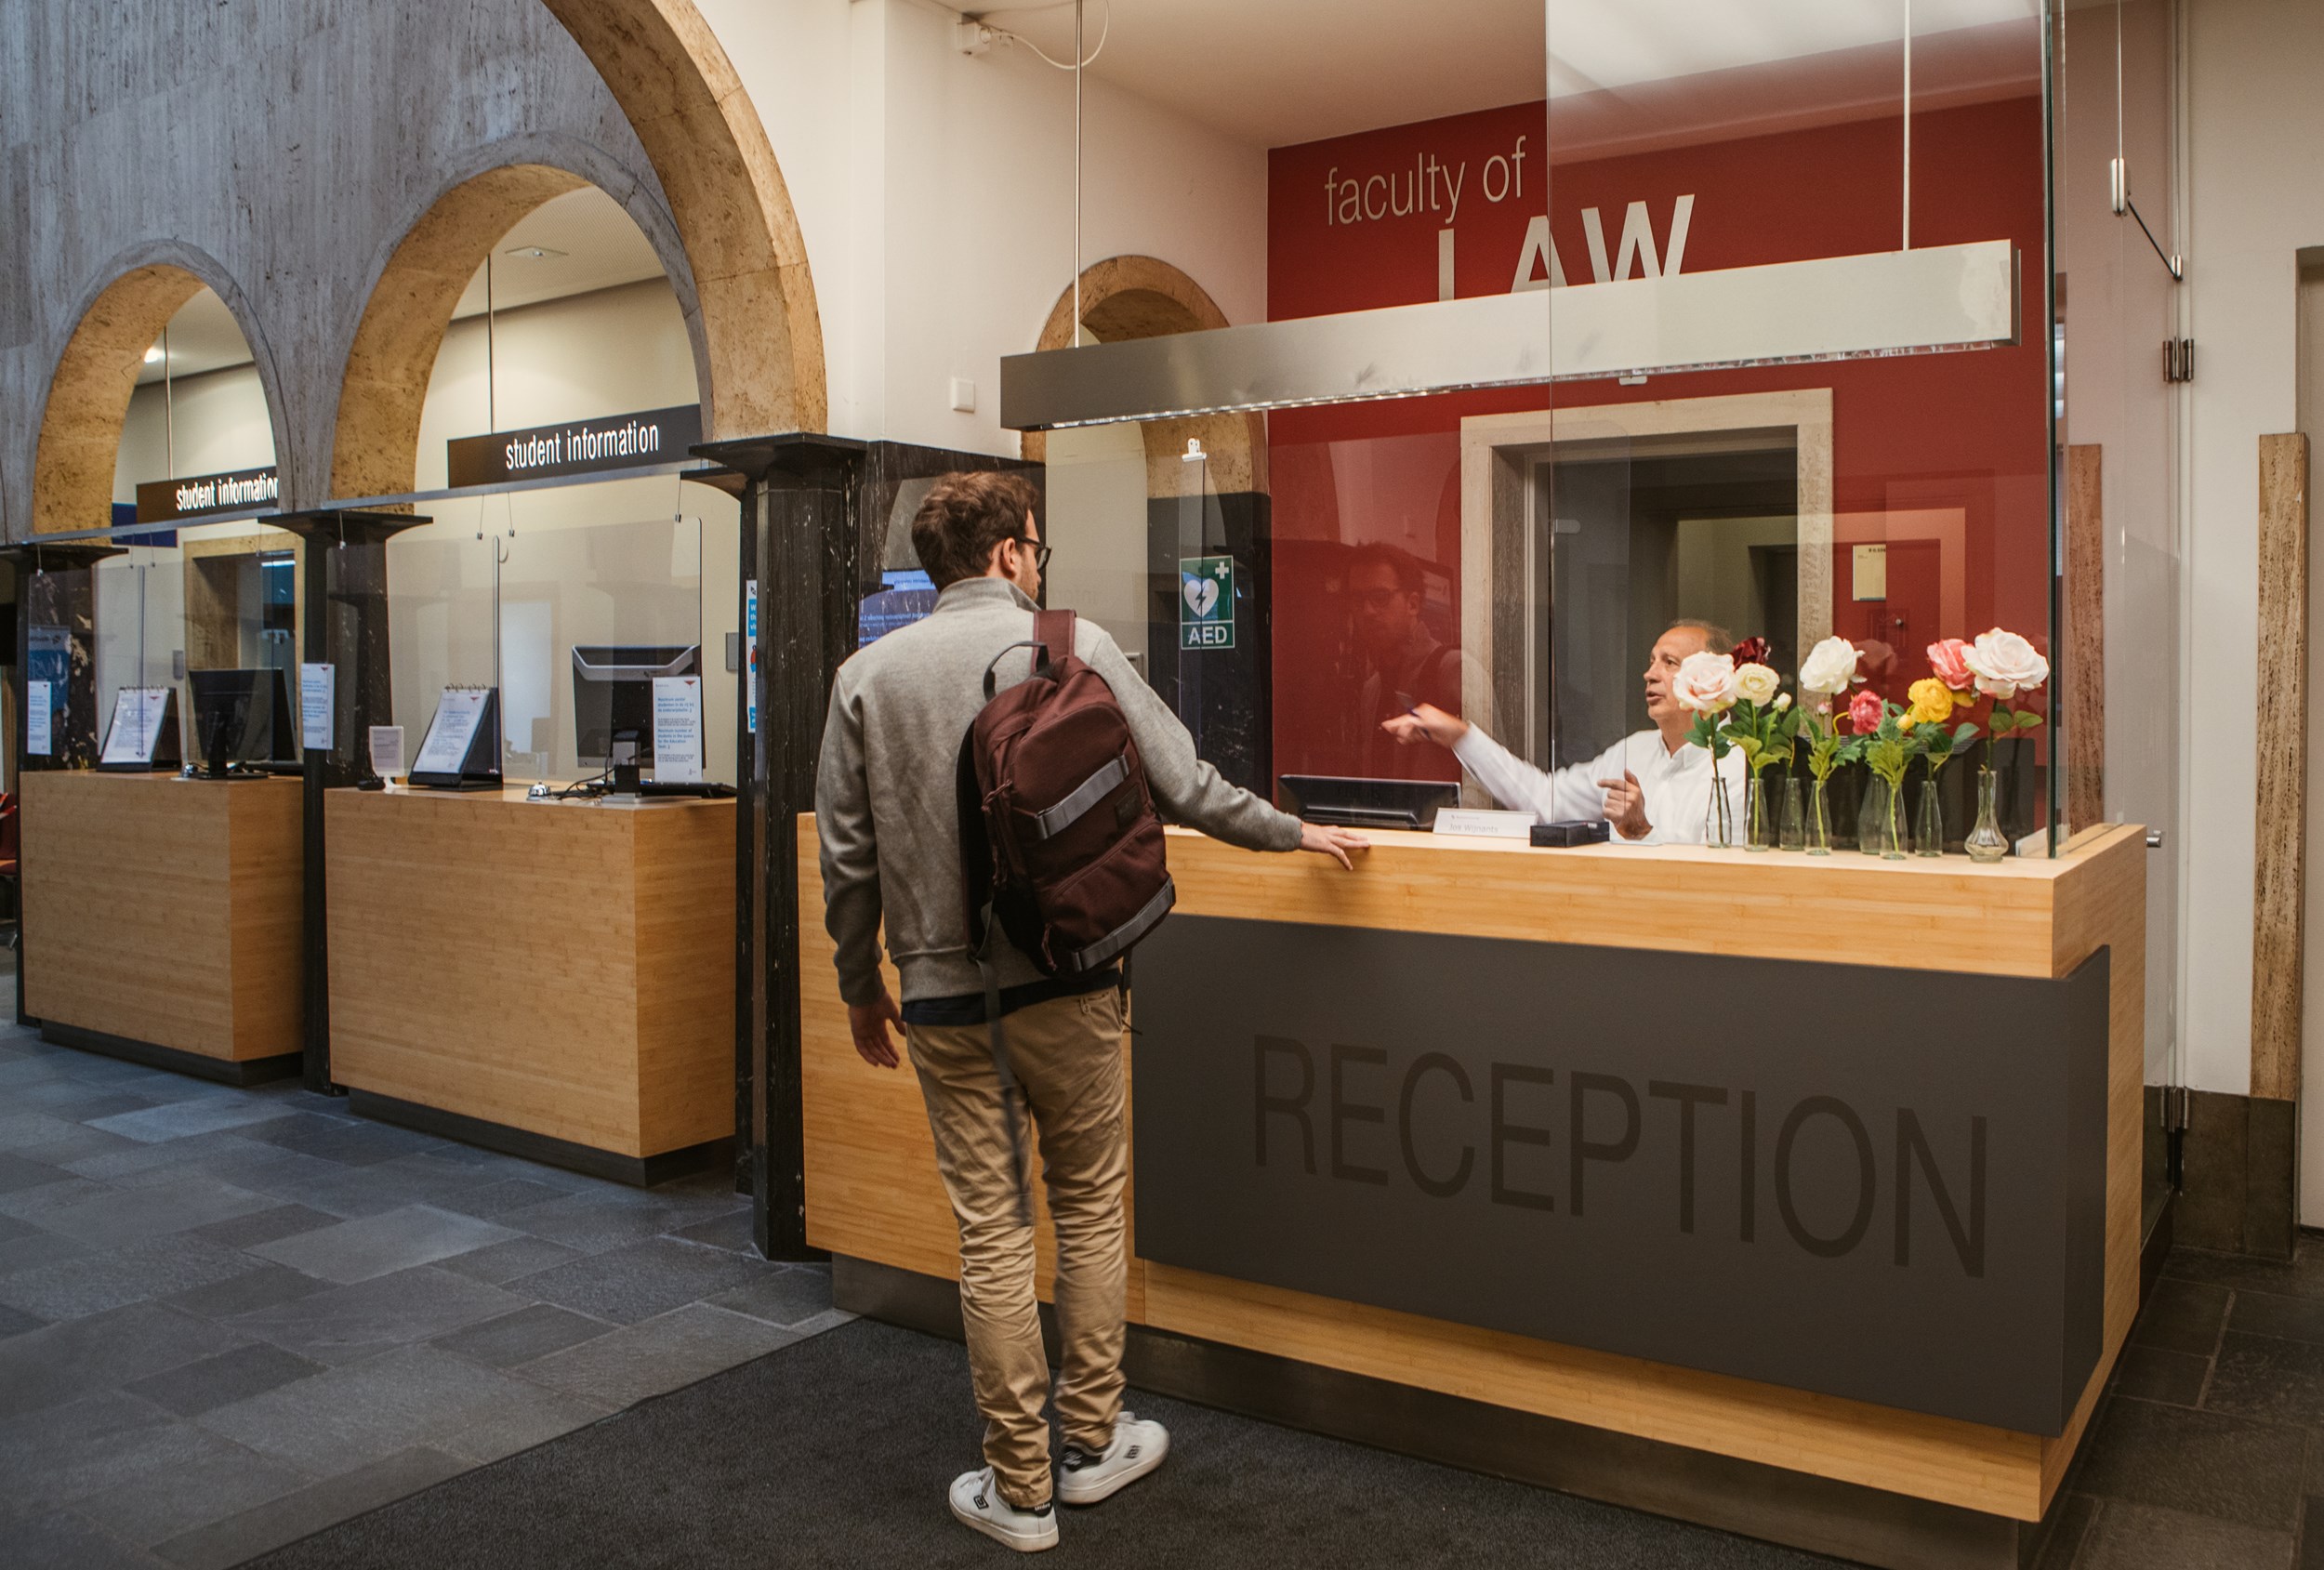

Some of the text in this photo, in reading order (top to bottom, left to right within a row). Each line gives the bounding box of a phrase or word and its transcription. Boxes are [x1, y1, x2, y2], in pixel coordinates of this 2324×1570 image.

[1324, 134, 1527, 225] faculty of
[506, 419, 659, 470] student information
[176, 481, 216, 511] student
[1188, 626, 1227, 645] AED
[1253, 1034, 1988, 1279] RECEPTION
